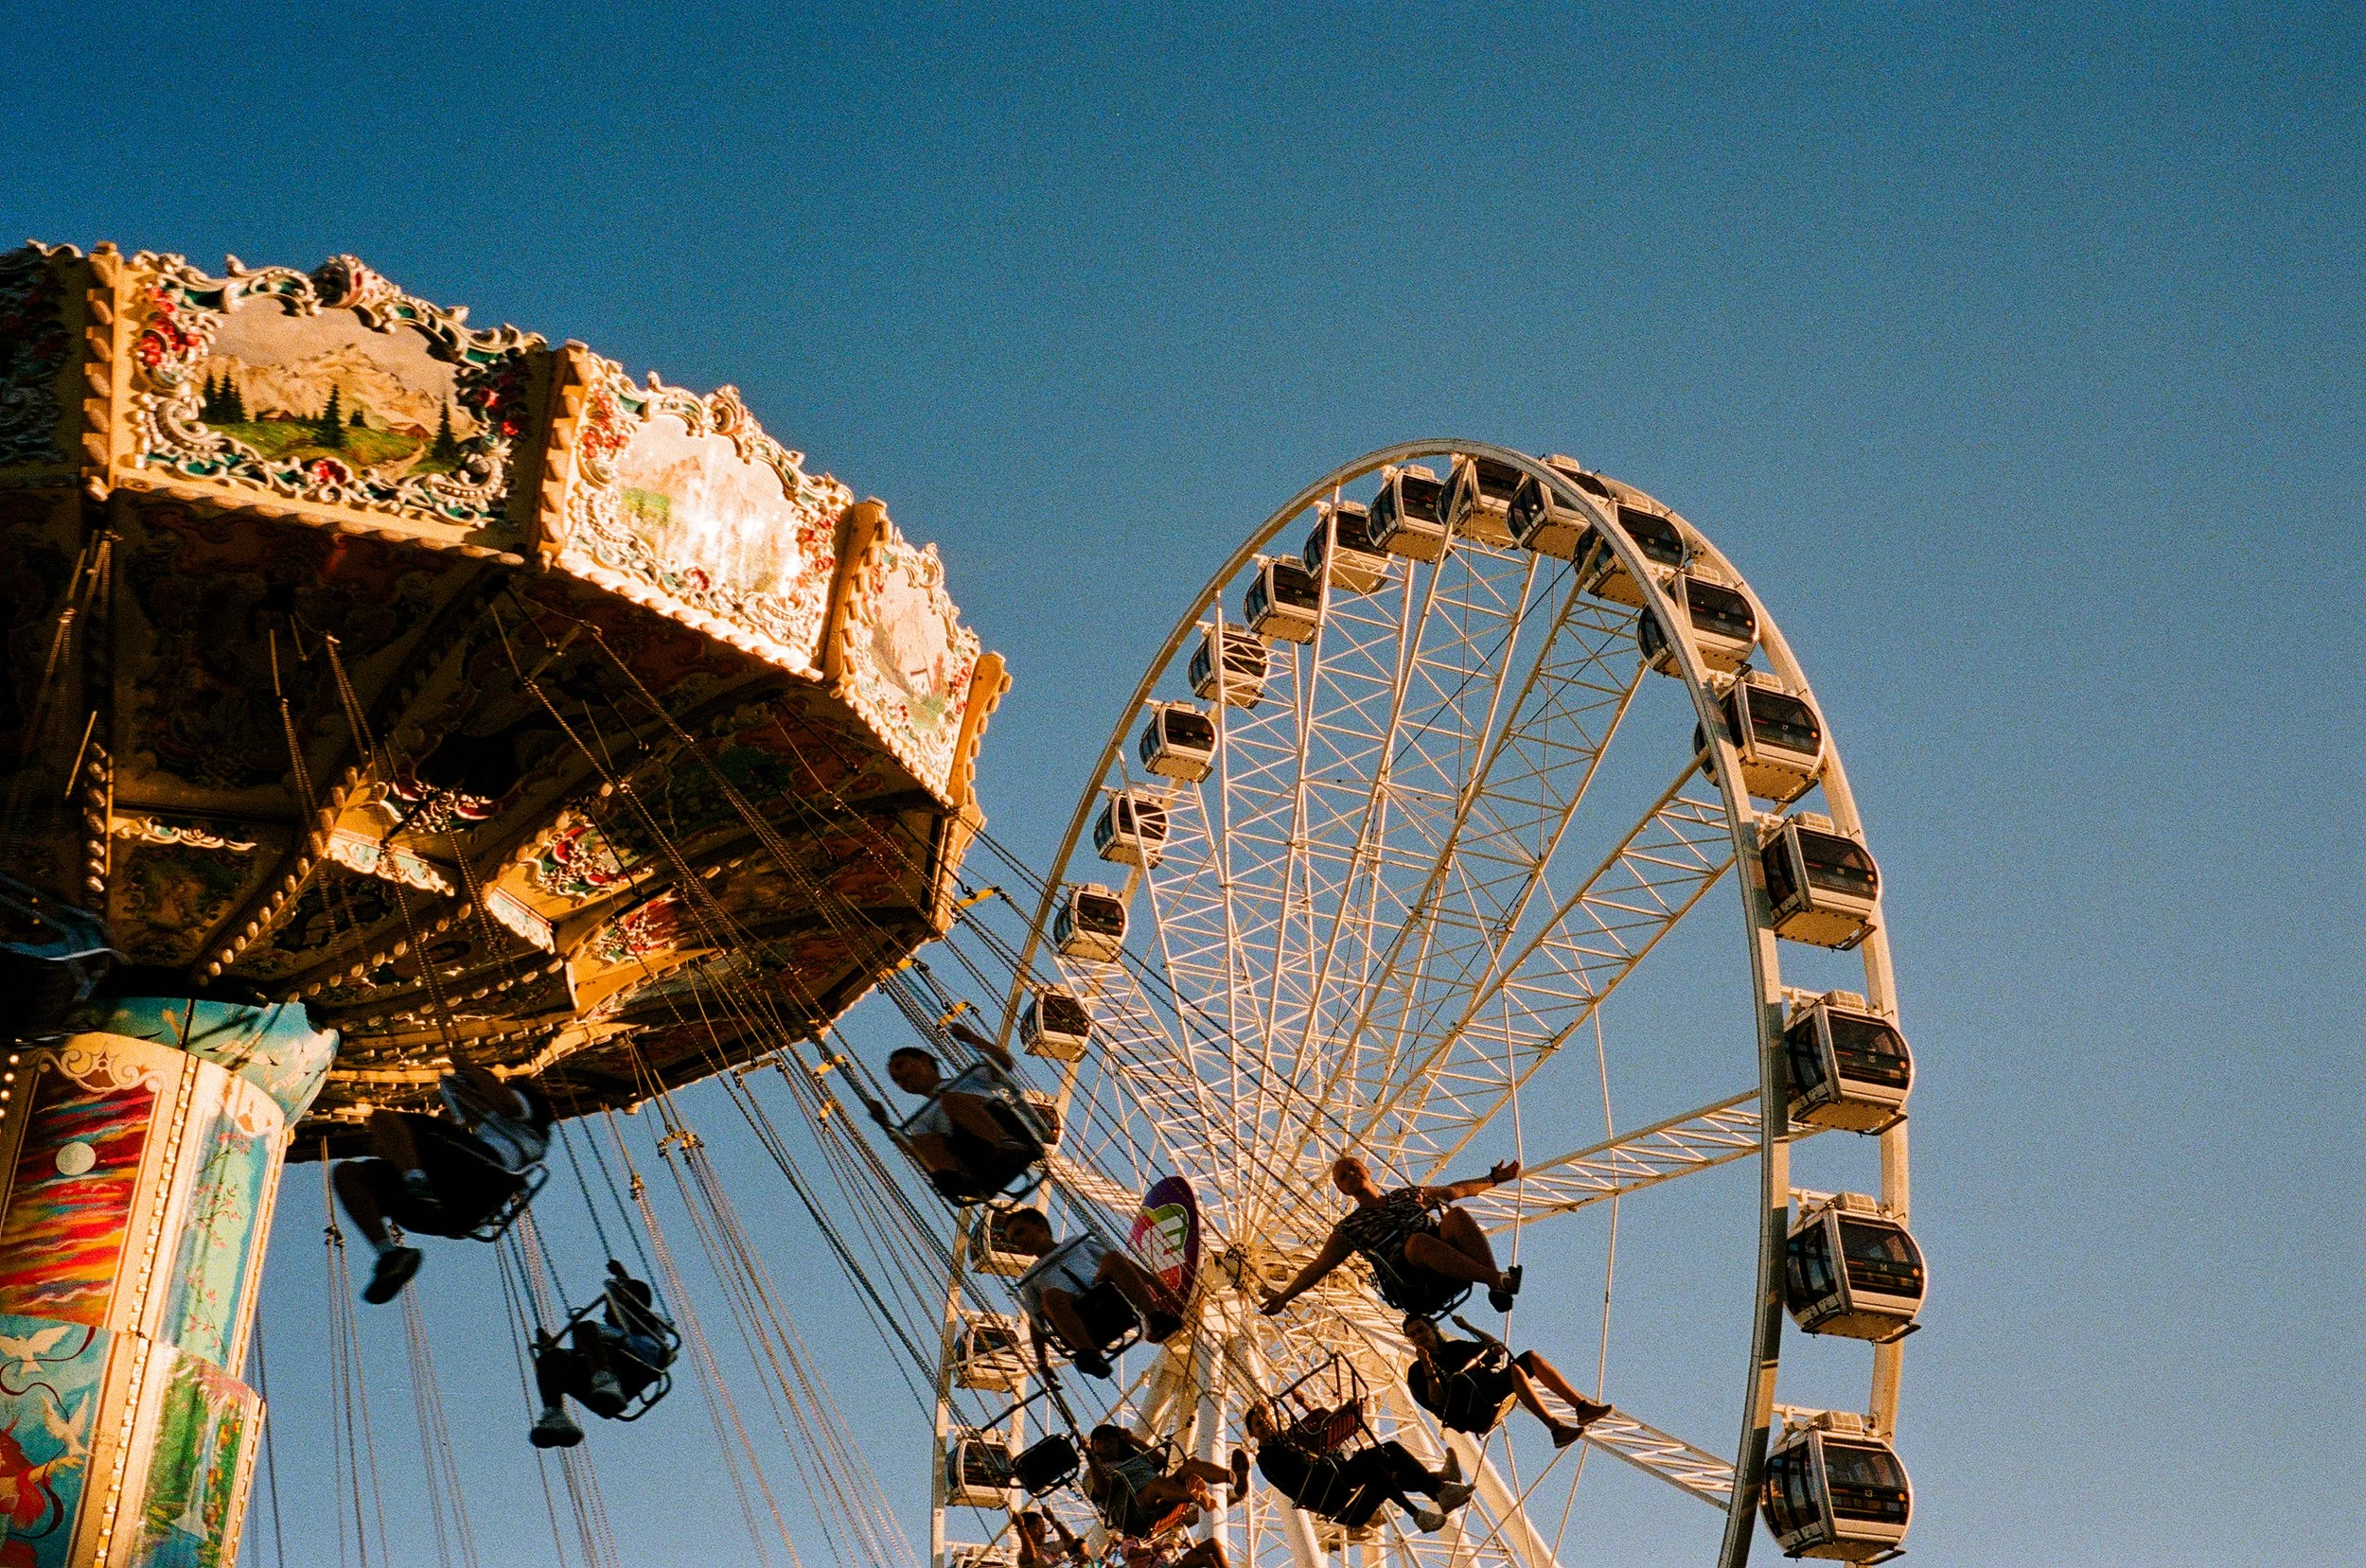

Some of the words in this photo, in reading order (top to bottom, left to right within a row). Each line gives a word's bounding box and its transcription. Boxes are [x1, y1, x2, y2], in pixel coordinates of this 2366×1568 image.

[1867, 1054, 1876, 1064] 15
[1880, 1263, 1888, 1272] 14
[1864, 1489, 1873, 1498] 13
